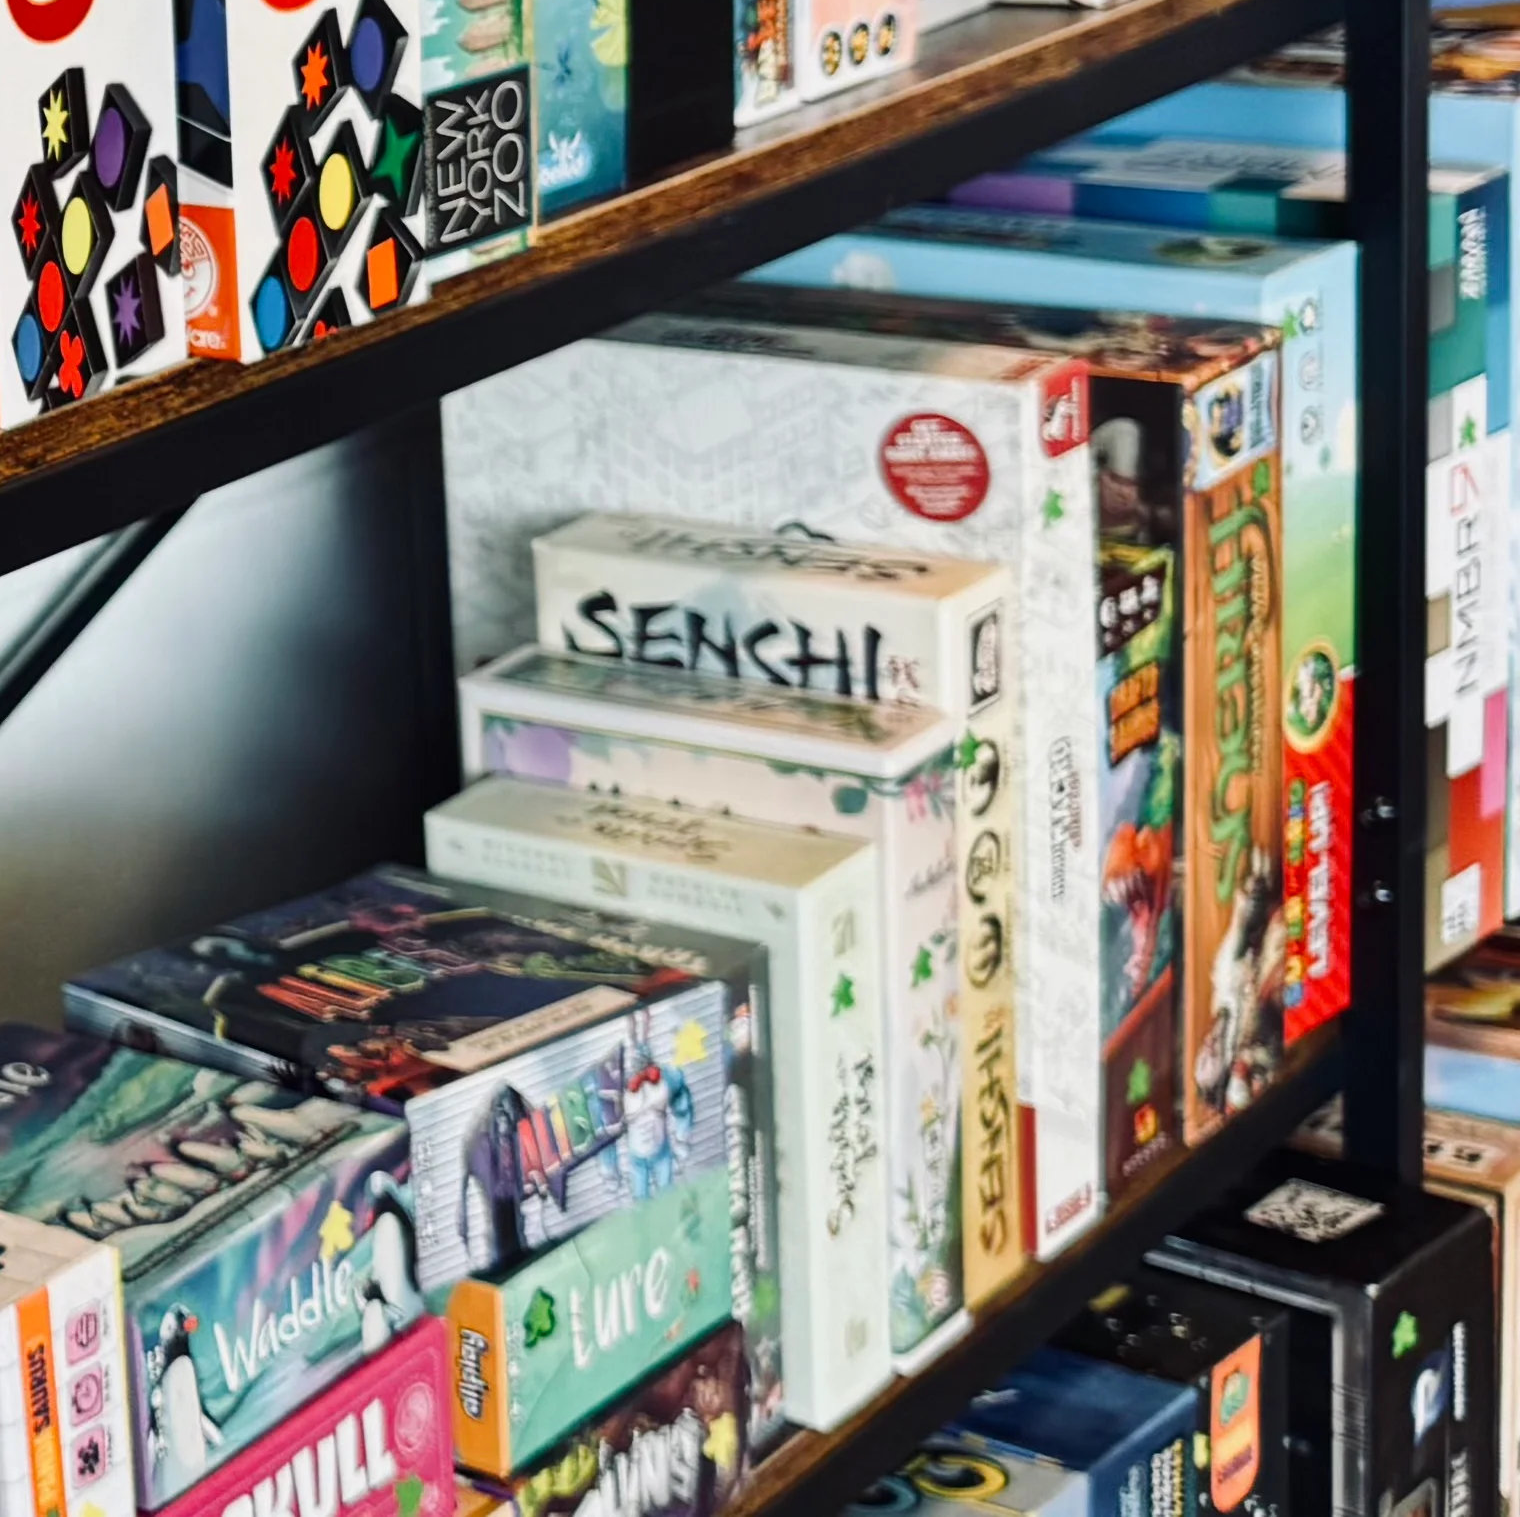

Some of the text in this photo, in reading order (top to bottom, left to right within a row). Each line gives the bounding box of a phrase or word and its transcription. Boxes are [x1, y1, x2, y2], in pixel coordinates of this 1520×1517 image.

[435, 100, 470, 243] NEW
[466, 89, 493, 234] YORK
[491, 80, 526, 224] ZOO
[1452, 515, 1484, 698] NMBR
[213, 1257, 365, 1392] Waddle
[568, 1246, 671, 1370] Lure
